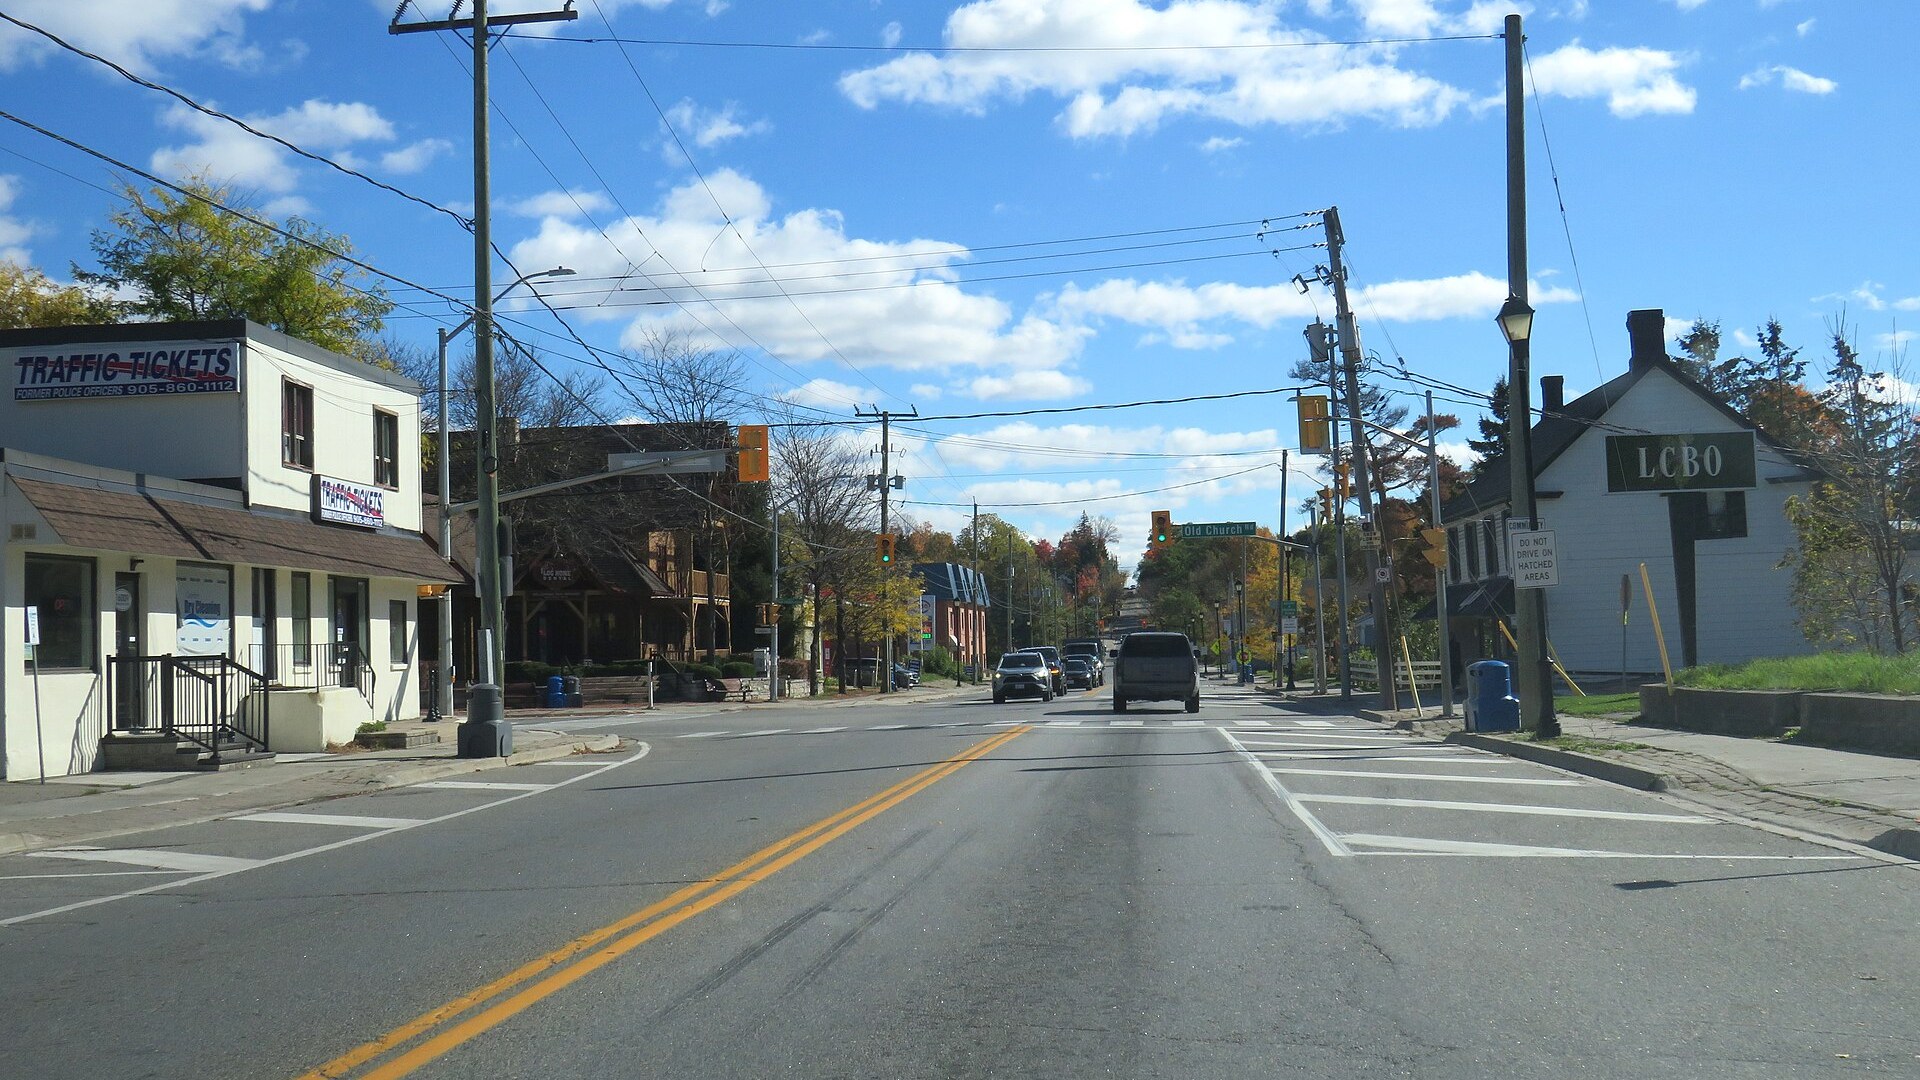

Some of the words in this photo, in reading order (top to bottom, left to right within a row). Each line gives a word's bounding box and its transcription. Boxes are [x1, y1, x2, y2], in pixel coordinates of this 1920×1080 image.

[18, 353, 119, 385] TRAFFIC
[128, 347, 232, 380] TICKETS
[16, 388, 50, 399] FORMER
[53, 386, 82, 398] POLICE
[84, 385, 123, 397] OFFICERS
[127, 380, 234, 395] 905-860-1112
[1638, 444, 1722, 478] LCBO
[321, 480, 352, 511] TRAFFIC
[353, 488, 383, 515] TICKETS
[1184, 525, 1201, 536] Old
[1206, 524, 1242, 535] Church
[1520, 539, 1530, 547] DO
[1533, 537, 1547, 546] NOT
[1517, 550, 1539, 559] DRIVE
[1542, 549, 1553, 557] ON
[1519, 560, 1553, 570] HATCHED
[1524, 572, 1550, 581] AREAS
